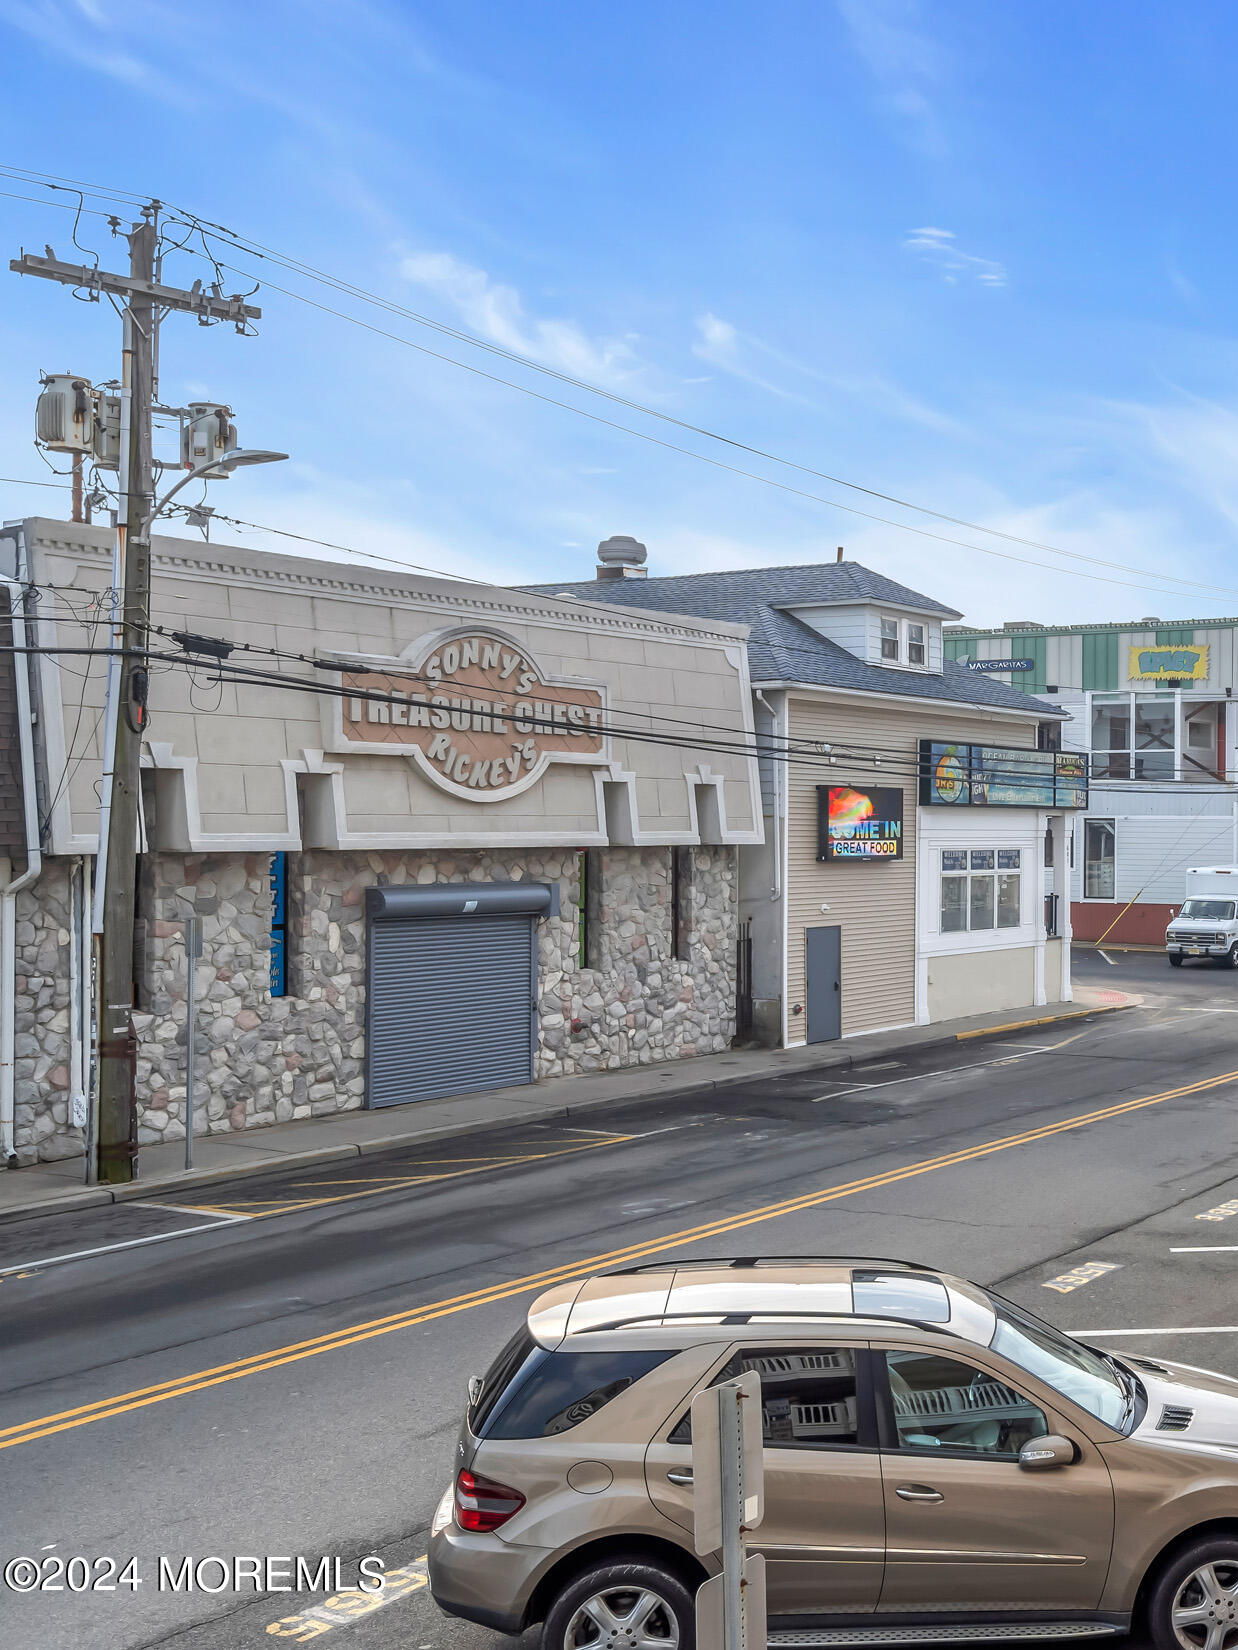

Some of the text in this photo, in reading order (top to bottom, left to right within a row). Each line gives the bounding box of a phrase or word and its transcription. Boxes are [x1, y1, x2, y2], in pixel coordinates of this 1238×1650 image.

[426, 638, 537, 694] SONNY'S
[968, 661, 1027, 670] MARGARITAS
[349, 687, 601, 738] TREASURE CHEST
[425, 733, 538, 788] RICKEY'S
[884, 821, 901, 838] IN
[836, 841, 895, 854] GREAT FOOD
